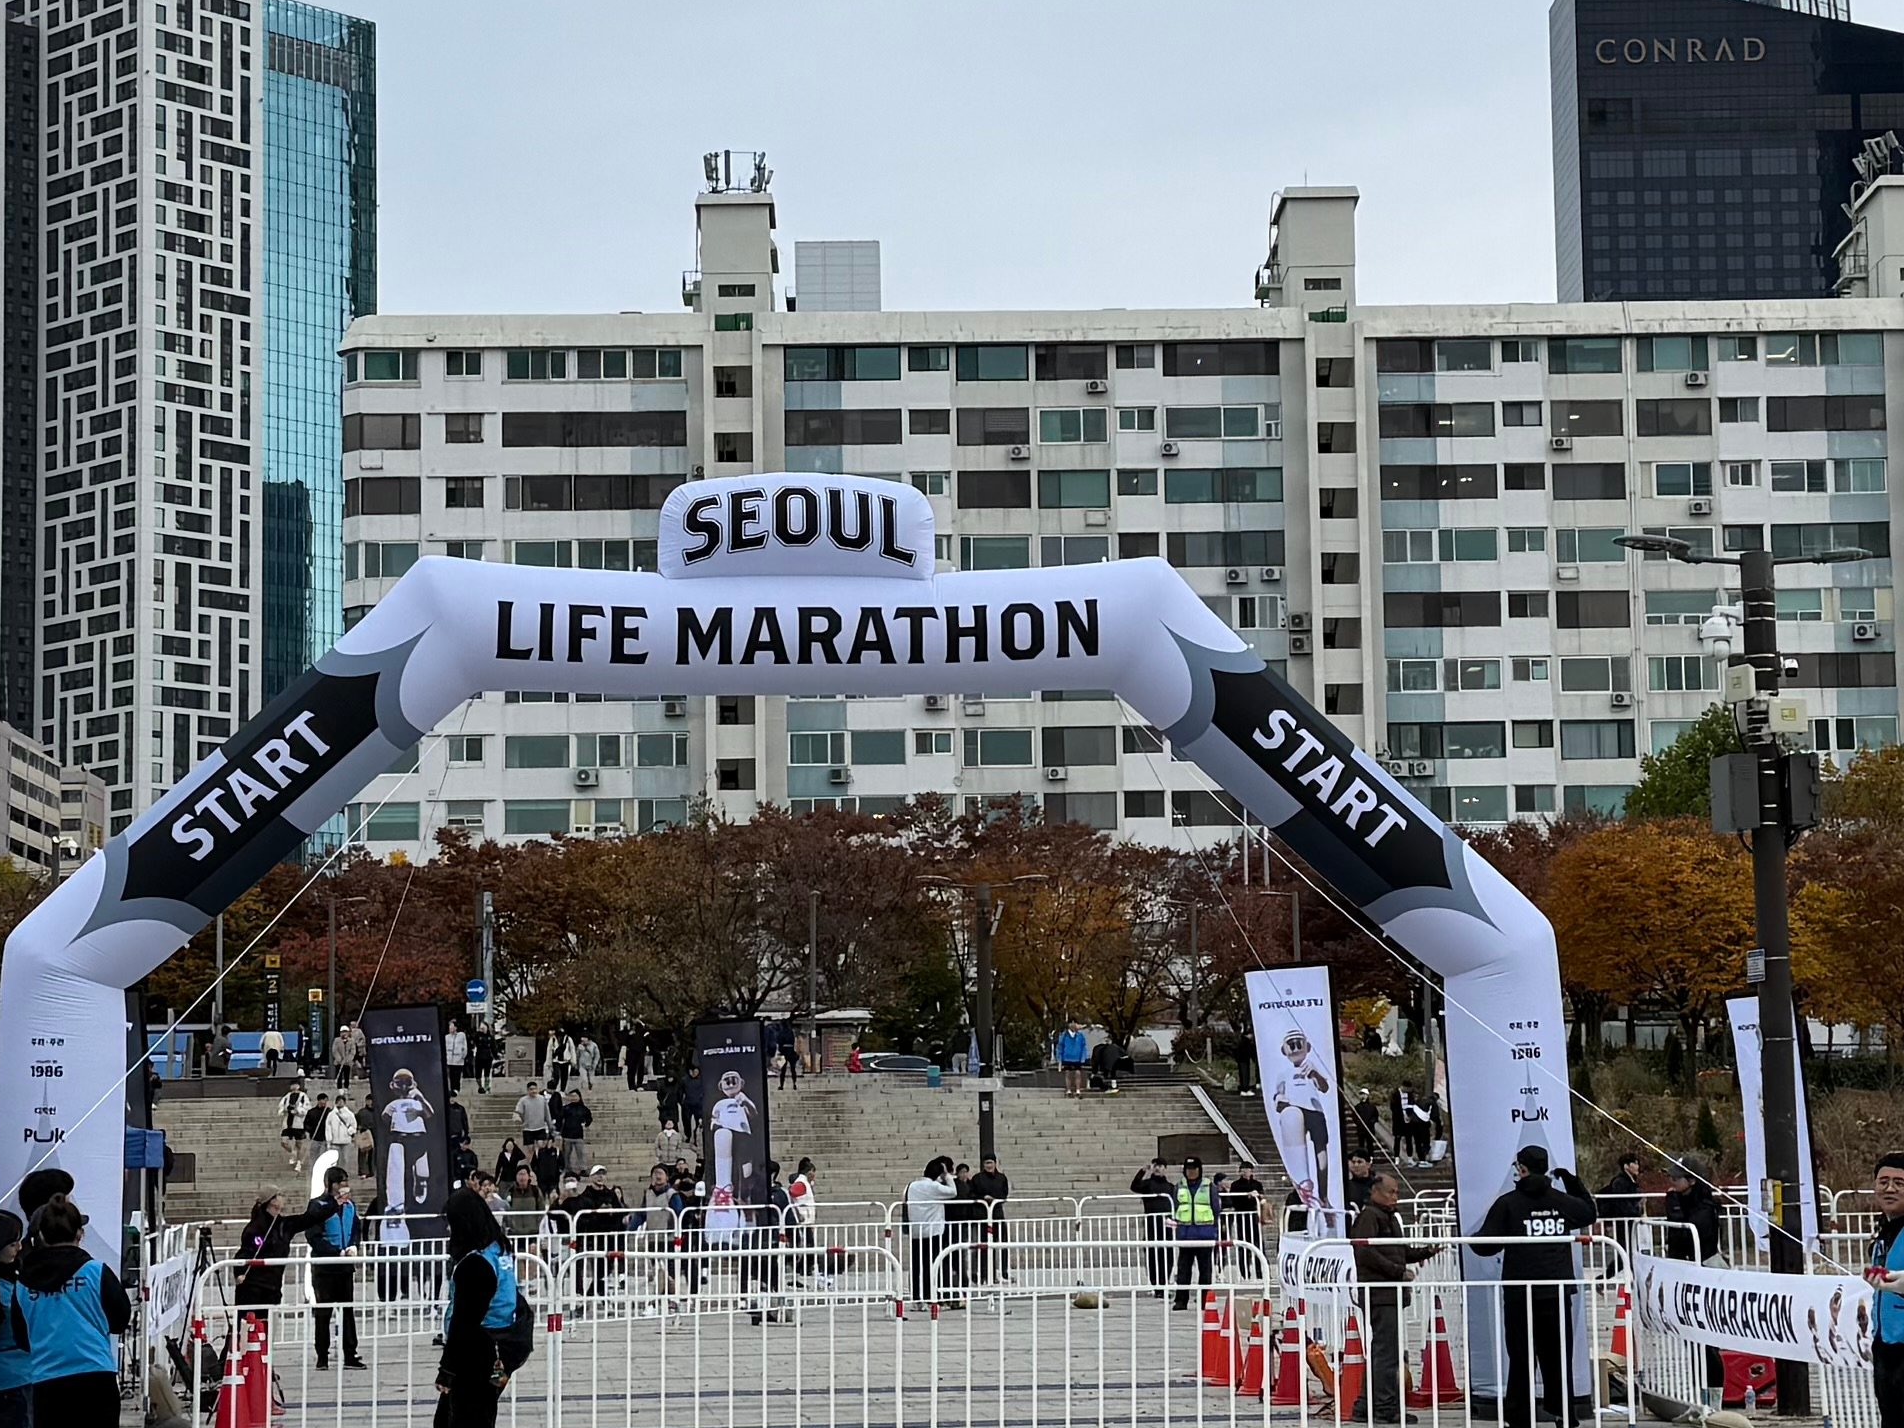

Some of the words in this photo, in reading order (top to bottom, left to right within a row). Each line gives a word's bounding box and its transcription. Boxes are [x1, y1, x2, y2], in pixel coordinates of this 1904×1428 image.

[1595, 36, 1766, 65] CONRAD
[682, 485, 919, 568] SEOUL
[495, 600, 649, 665] LIFE
[675, 598, 1099, 666] MARATHON
[171, 710, 331, 862] START
[1252, 709, 1408, 849] START
[30, 1065, 64, 1078] 1986
[1523, 1218, 1565, 1237] 1986
[1674, 1281, 1705, 1330] LIFE
[1704, 1287, 1799, 1344] MARATHON
